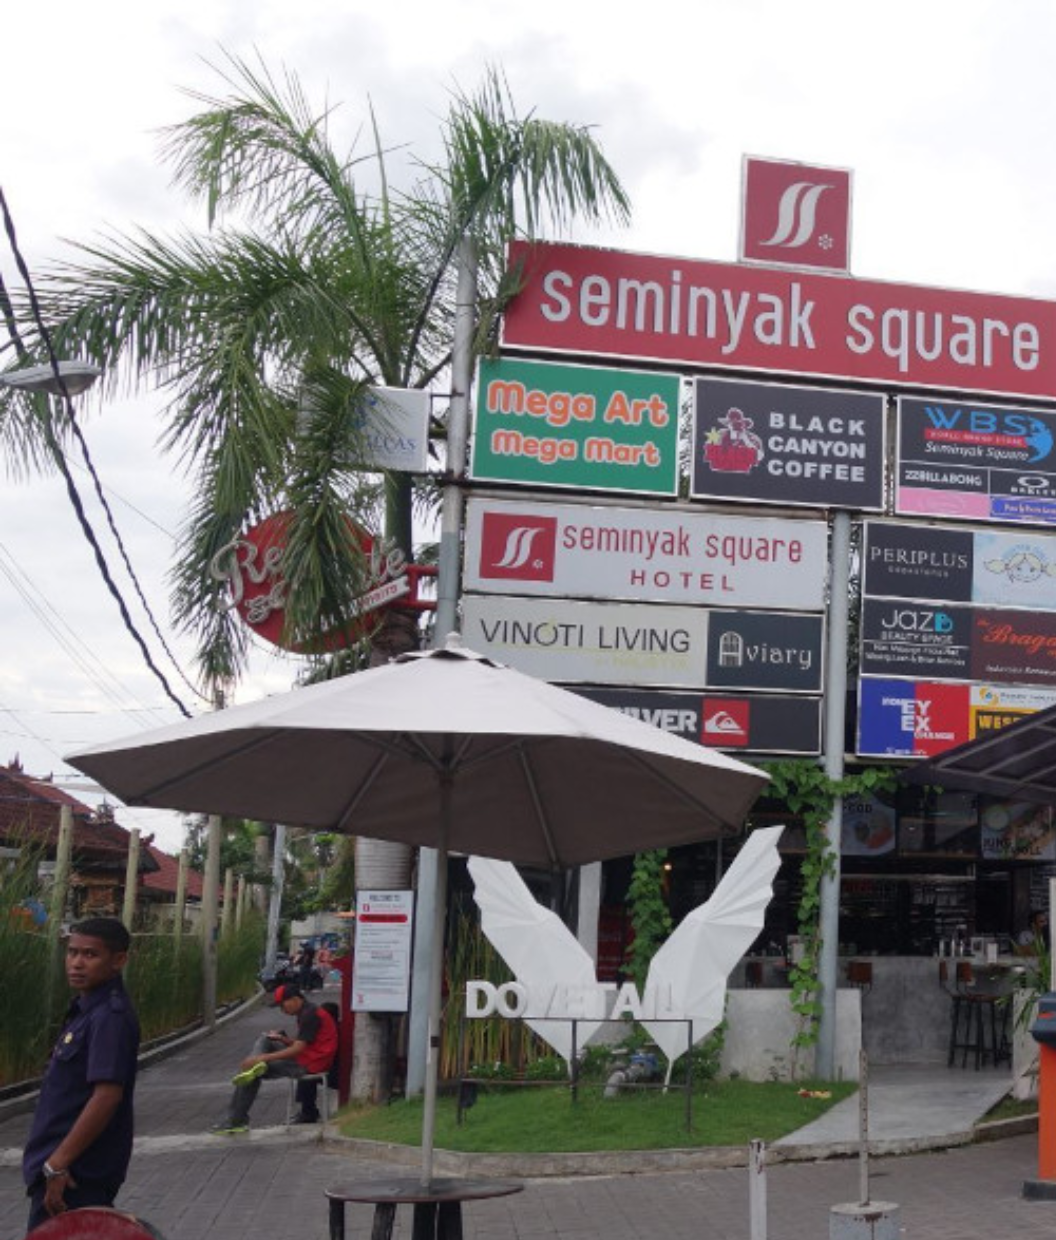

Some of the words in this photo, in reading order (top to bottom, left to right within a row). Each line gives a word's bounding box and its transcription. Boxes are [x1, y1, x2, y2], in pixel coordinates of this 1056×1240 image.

[540, 269, 816, 355] seminyak
[846, 304, 1040, 372] square
[487, 380, 596, 426] Mega
[604, 391, 669, 427] Art
[769, 412, 866, 437] BLACK
[924, 406, 1028, 436] WBS
[491, 428, 577, 464] Mega
[585, 437, 661, 467] Mart
[767, 435, 866, 460] CANYON
[924, 441, 984, 458] Seminyak
[986, 447, 1029, 461] Square
[767, 458, 866, 483] COFFEE
[562, 524, 691, 560] seminyak
[704, 534, 803, 566] square
[870, 546, 968, 569] PERIPLUS
[630, 569, 735, 592] HOTEL
[479, 618, 584, 648] VINOTI
[599, 626, 691, 653] LIVING
[718, 630, 812, 670] Aviary
